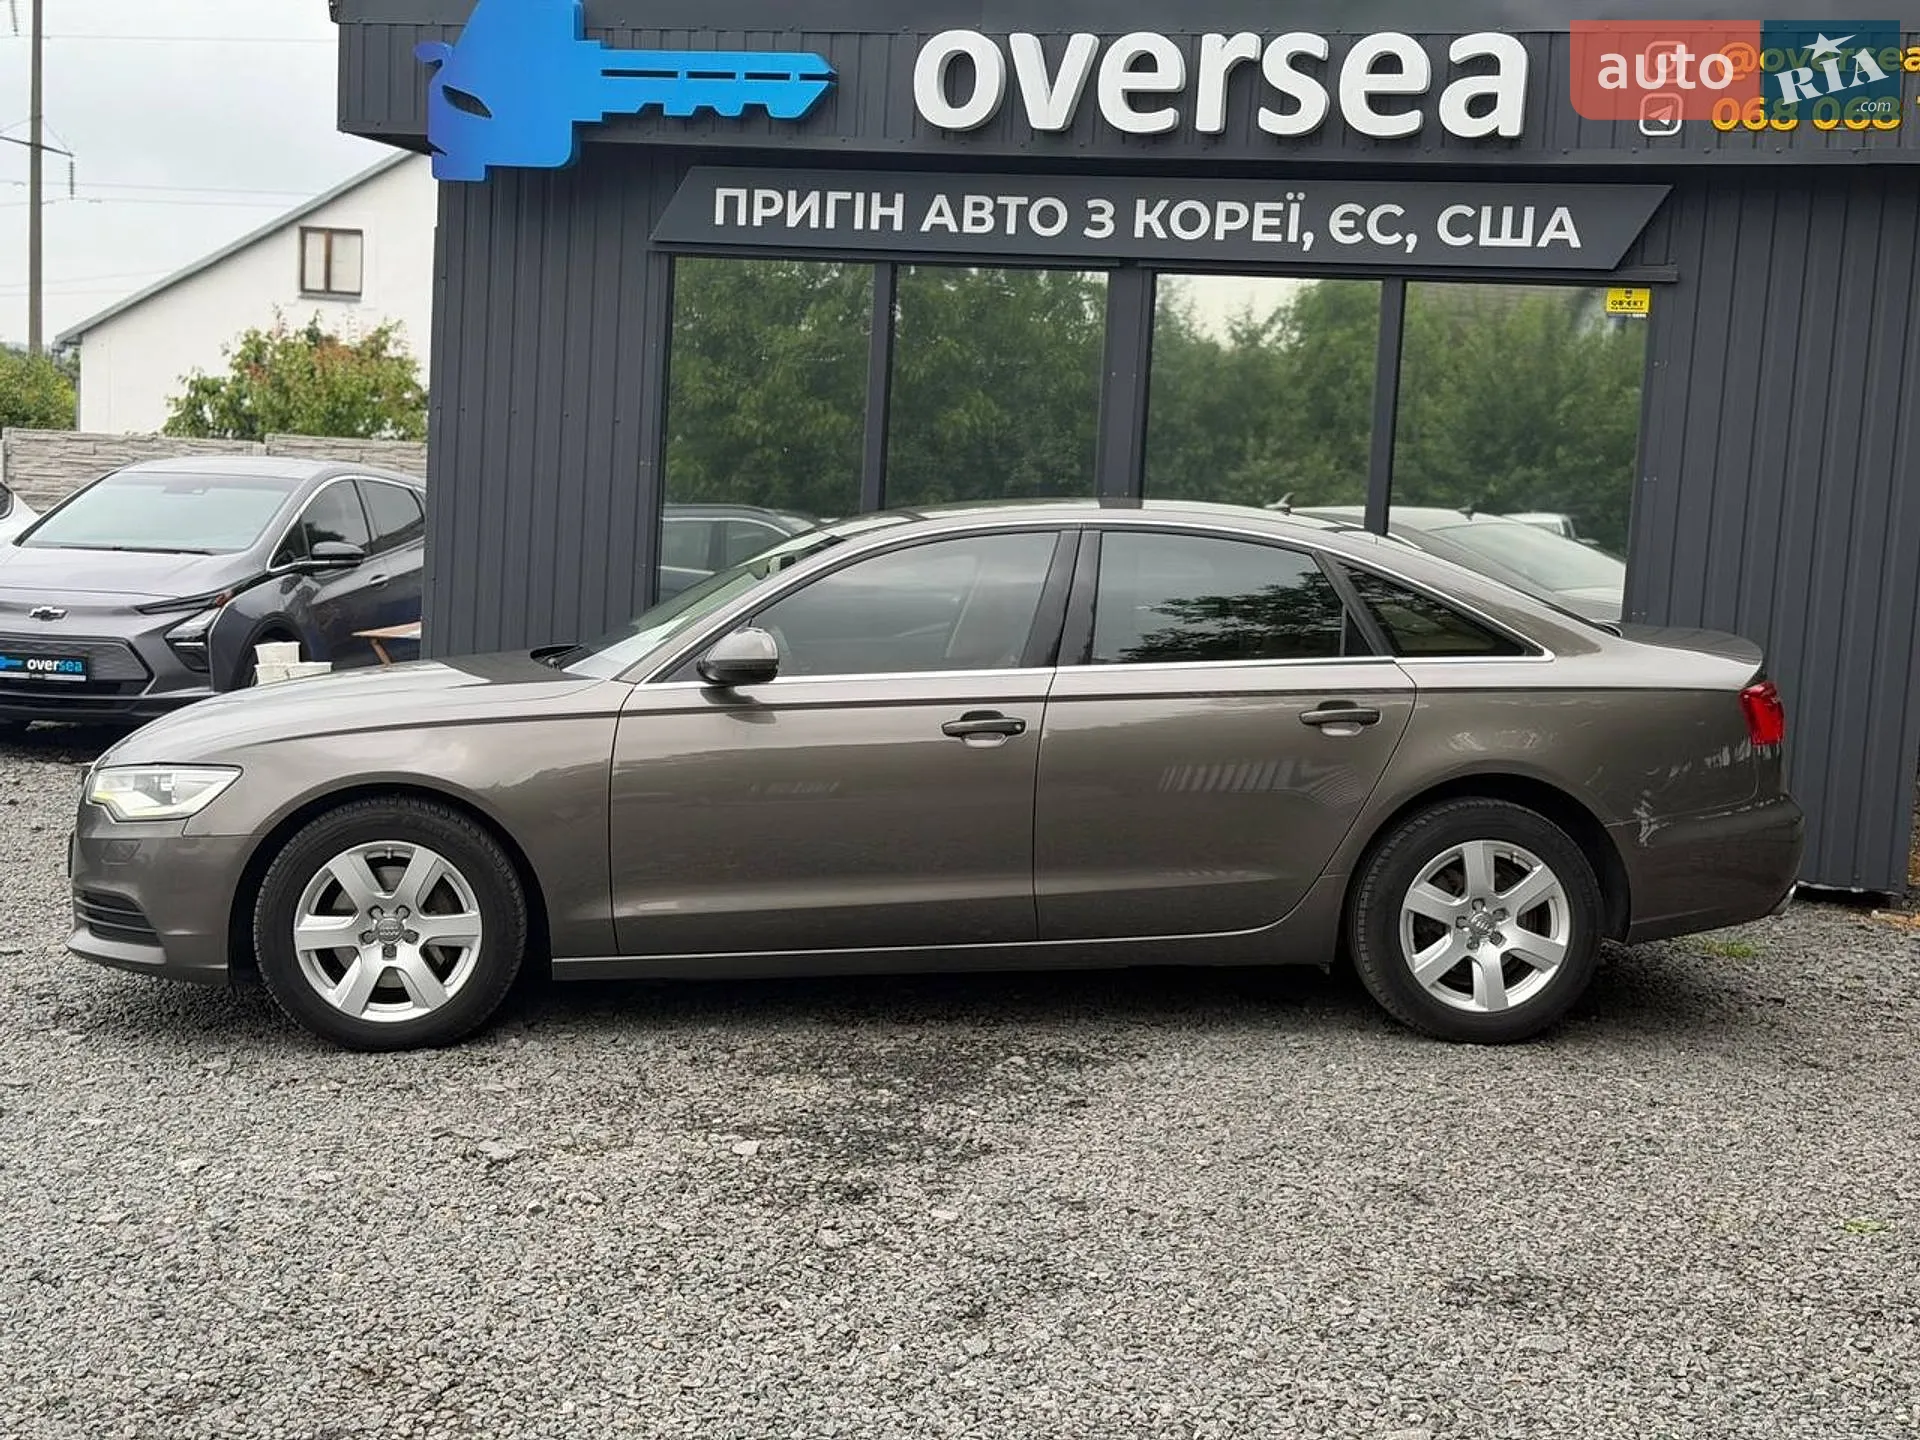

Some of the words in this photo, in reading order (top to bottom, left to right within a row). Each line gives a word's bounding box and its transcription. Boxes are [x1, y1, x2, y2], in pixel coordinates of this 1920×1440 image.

[913, 29, 1529, 137] oversea
[1711, 97, 1799, 132] 068
[1812, 96, 1903, 132] 068
[713, 187, 905, 231] ПРИГІН
[919, 193, 1069, 238] АВТО
[1083, 199, 1115, 239] З
[1132, 192, 1314, 252] КОРЕЇ,
[1328, 203, 1418, 253] ЄС,
[1436, 203, 1582, 249] США
[27, 658, 83, 672] oversea
